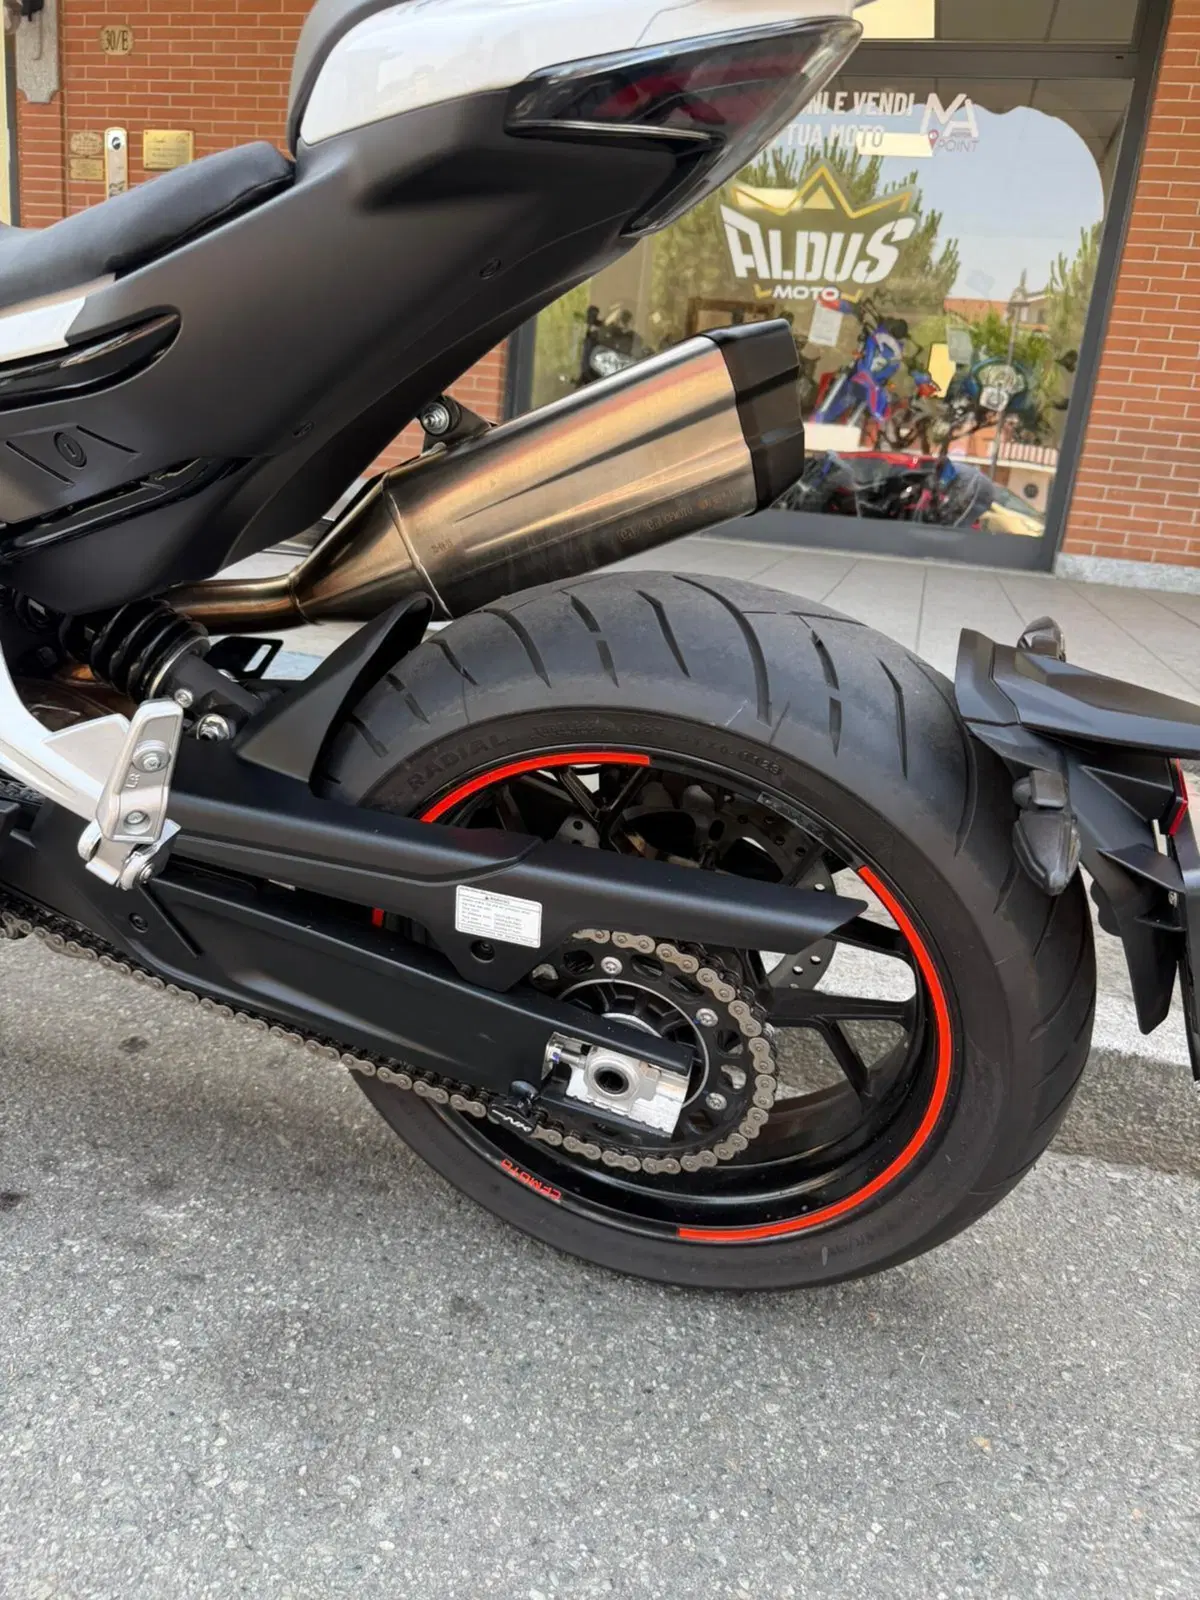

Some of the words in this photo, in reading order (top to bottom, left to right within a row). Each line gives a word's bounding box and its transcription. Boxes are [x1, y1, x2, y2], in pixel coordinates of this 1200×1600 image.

[834, 91, 849, 115] E
[853, 92, 916, 116] VENDI
[787, 123, 825, 149] TUA
[828, 124, 886, 149] MOTO
[937, 138, 979, 153] POINT
[720, 204, 917, 284] ALDUS
[772, 285, 840, 301] MOTO
[405, 732, 508, 792] RADIAL
[501, 1158, 562, 1201] CFMOTO
